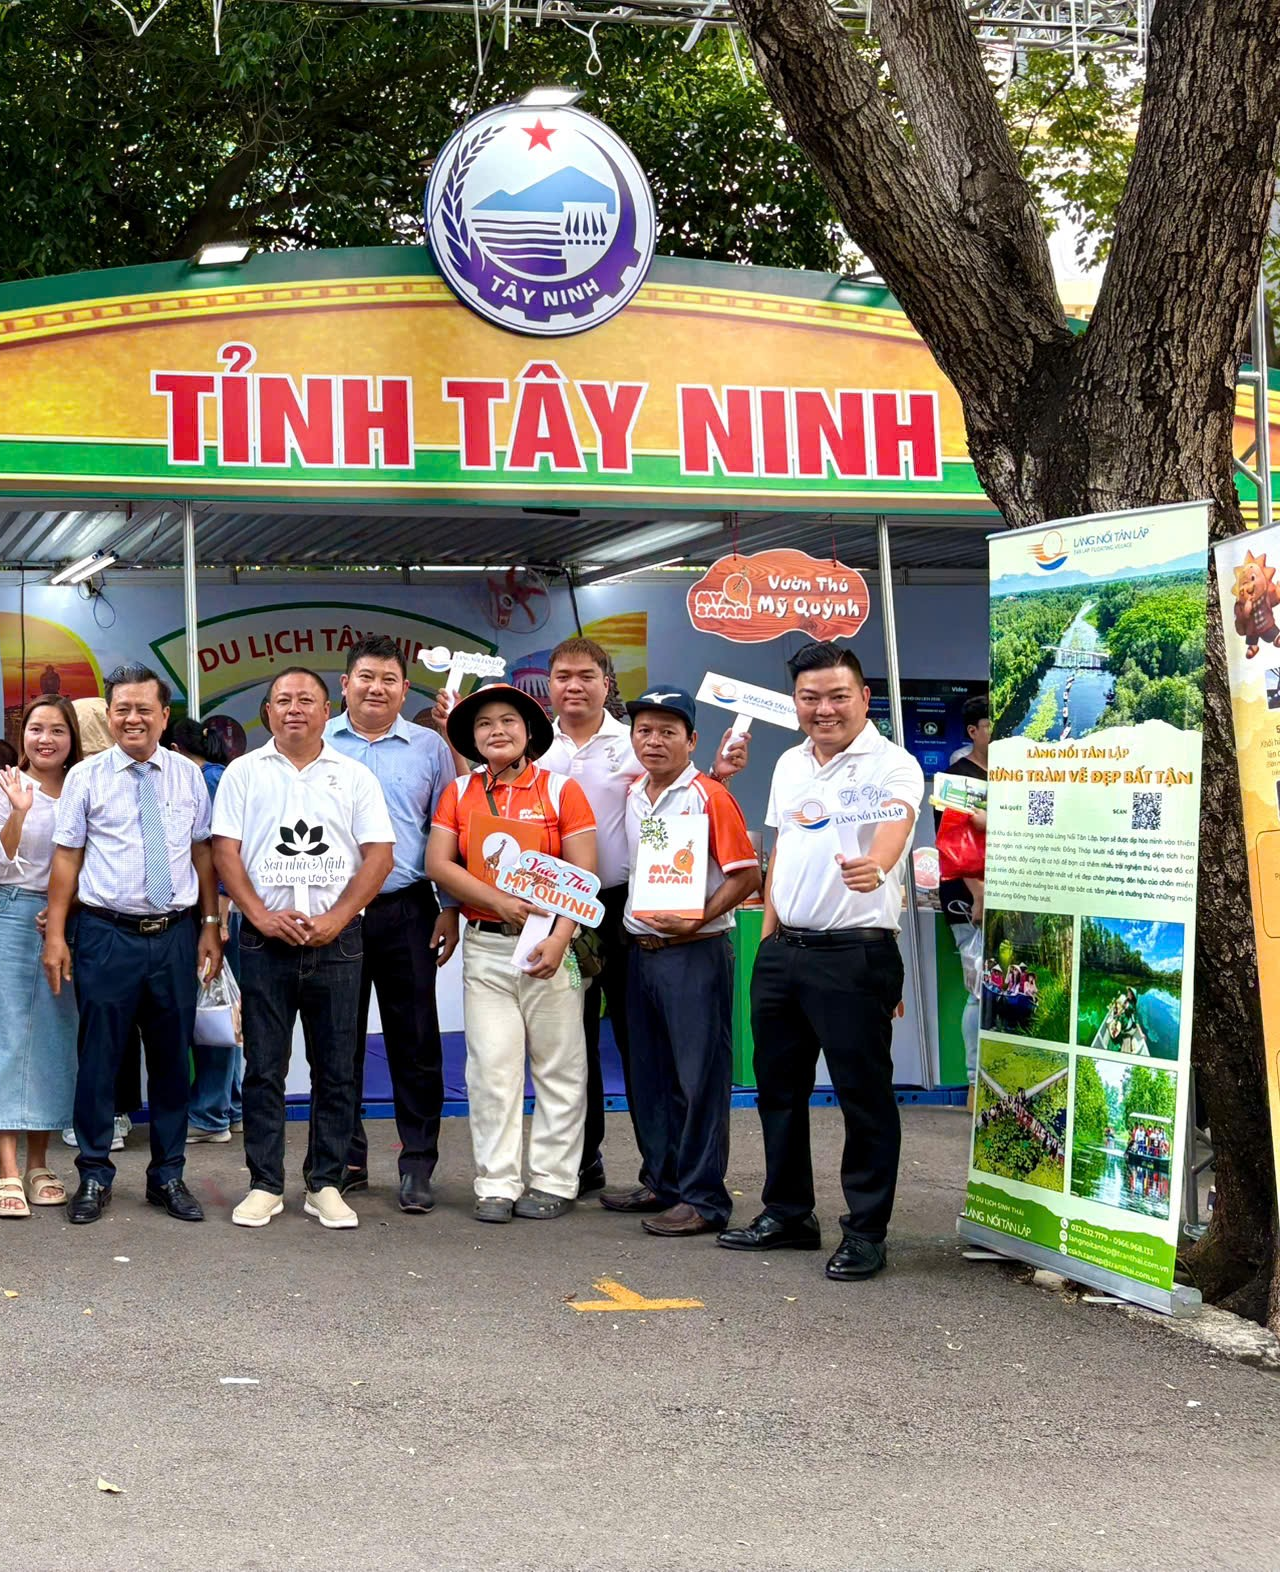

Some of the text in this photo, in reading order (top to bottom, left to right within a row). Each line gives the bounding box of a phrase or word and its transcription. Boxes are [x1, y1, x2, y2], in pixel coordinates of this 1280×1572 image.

[490, 275, 600, 307] TÂY NINH
[150, 341, 943, 482] TỈNH TÂY NINH
[1114, 529, 1132, 542] TÂN
[1133, 526, 1150, 540] LẬP
[768, 575, 849, 592] Vườn Thú
[695, 591, 723, 605] MY
[695, 604, 751, 619] SAFARI
[757, 595, 860, 620] Mỹ Quỳnh
[198, 639, 239, 673] DU
[247, 629, 313, 664] LỊCH
[1027, 746, 1056, 758] LÀNG
[1081, 745, 1106, 758] TÂN
[1108, 745, 1130, 760] LẬP
[989, 766, 1023, 782] RỪNG
[1026, 766, 1066, 783] TRÀM
[1090, 770, 1121, 787] ĐẸP
[1123, 765, 1153, 784] BẤT
[1155, 767, 1193, 787] TẬN
[836, 814, 856, 824] LÀNG
[872, 809, 887, 819] TÂN
[889, 807, 903, 818] LẬP
[648, 864, 671, 874] MY
[285, 875, 307, 885] Long
[330, 874, 346, 883] Sen
[563, 871, 593, 894] Thú
[648, 875, 693, 884] SAFARI
[534, 882, 599, 921] QUỲNH
